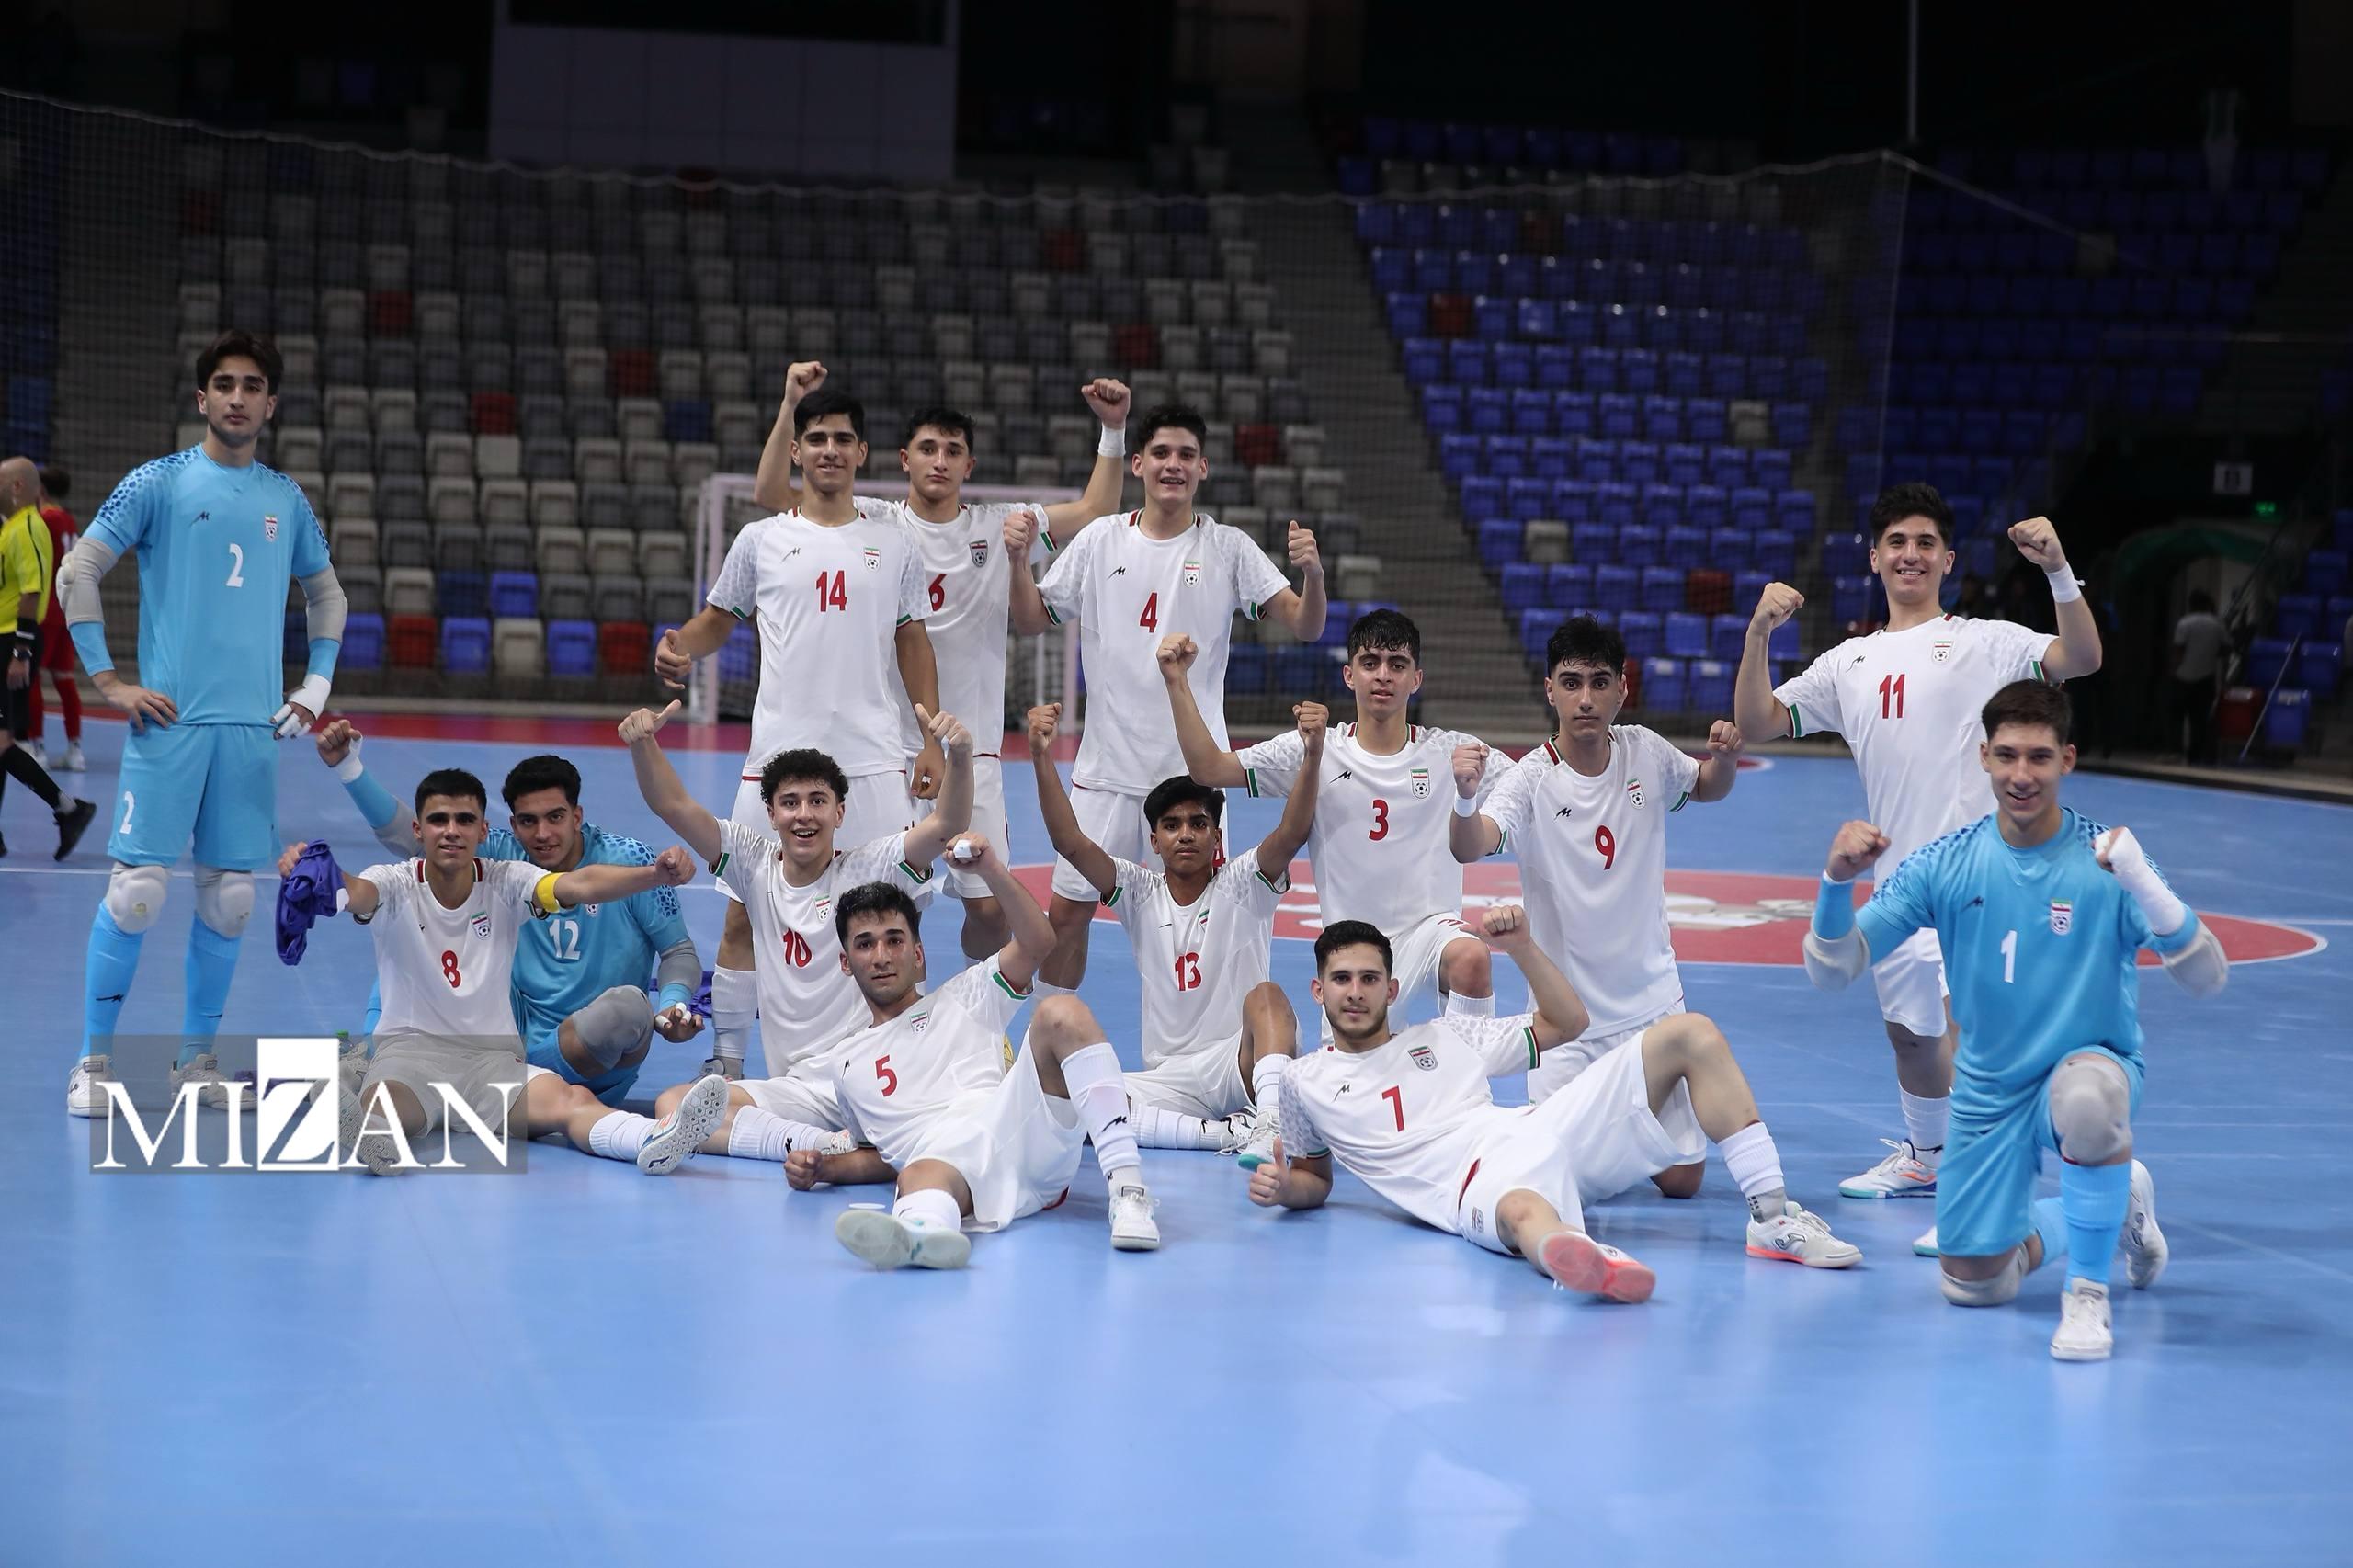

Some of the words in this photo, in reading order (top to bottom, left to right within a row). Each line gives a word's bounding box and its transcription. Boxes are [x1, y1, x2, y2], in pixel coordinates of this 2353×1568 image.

[226, 543, 244, 588] 2
[815, 569, 847, 612] 14
[927, 573, 947, 612] 6
[1139, 592, 1158, 633] 4
[1878, 673, 1905, 720] 11
[119, 790, 135, 835] 2
[1369, 798, 1389, 841] 3
[1595, 824, 1616, 869] 9
[549, 918, 581, 960] 12
[782, 930, 812, 968] 10
[2000, 930, 2018, 983] 1
[441, 949, 461, 988] 8
[1174, 951, 1202, 991] 13
[875, 1054, 898, 1097] 5
[1381, 1085, 1405, 1132] 7
